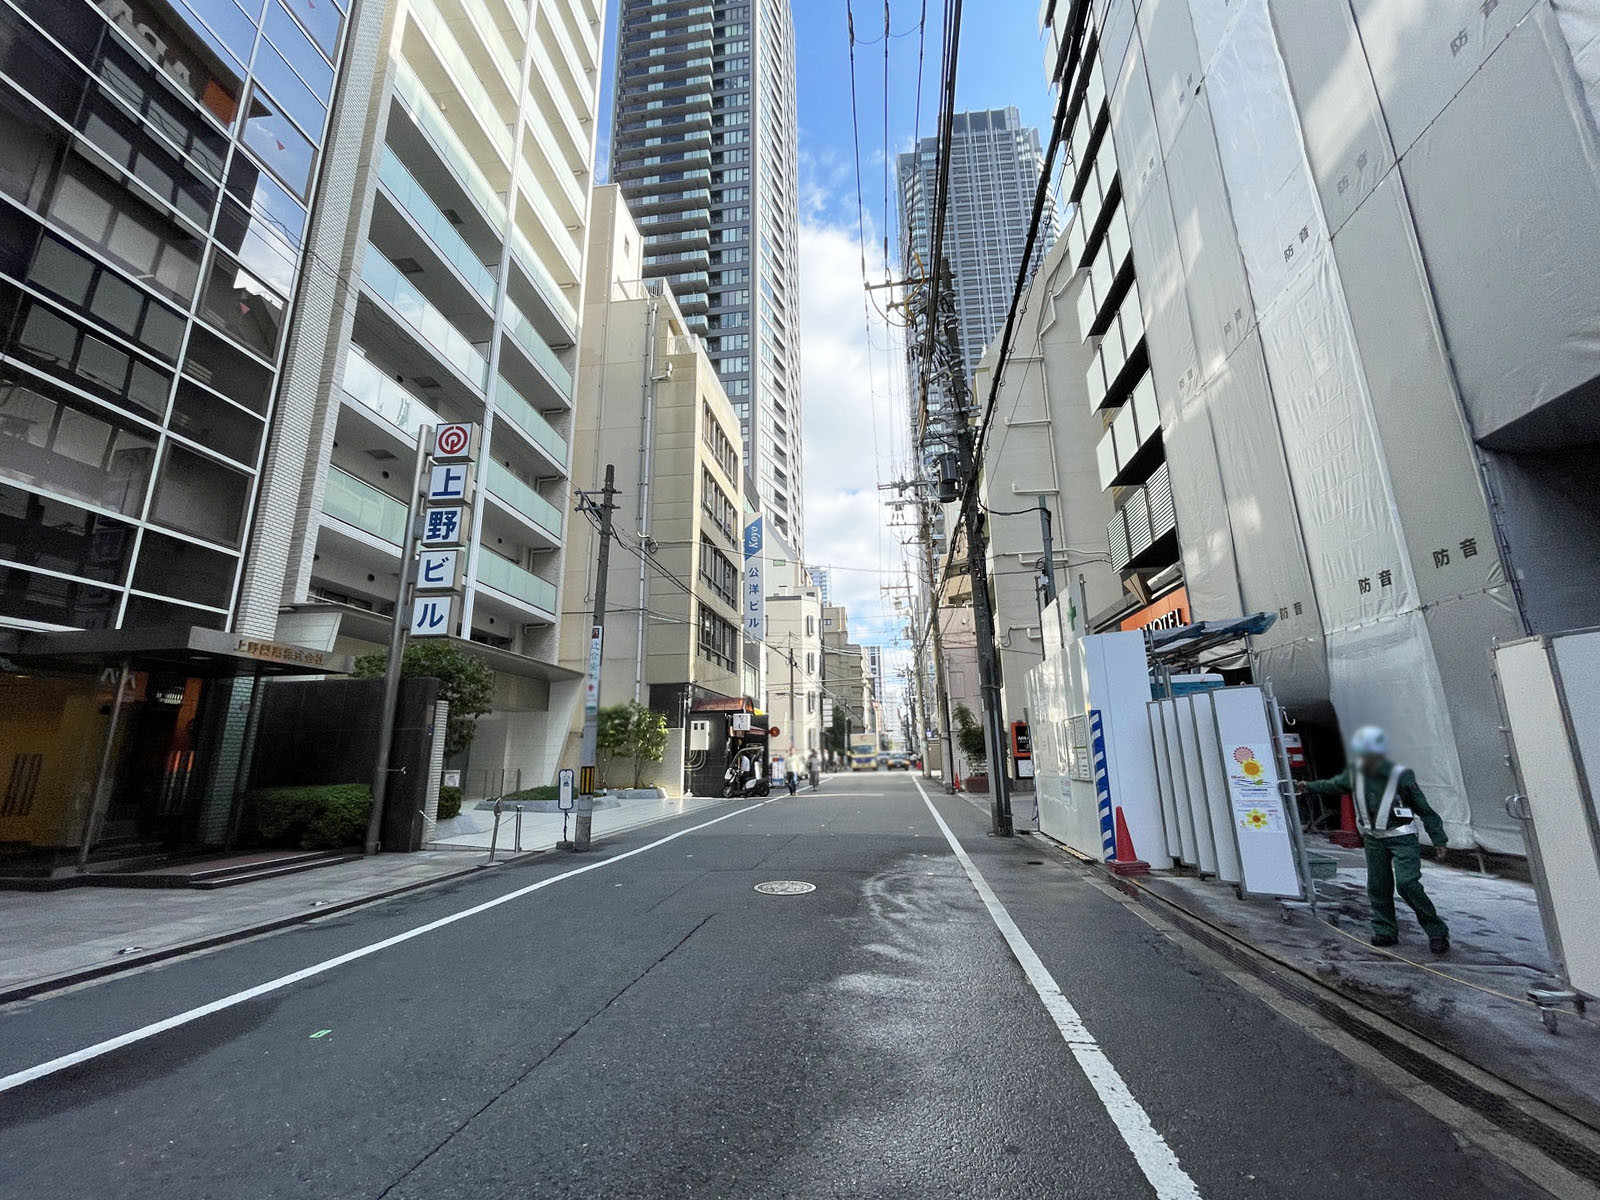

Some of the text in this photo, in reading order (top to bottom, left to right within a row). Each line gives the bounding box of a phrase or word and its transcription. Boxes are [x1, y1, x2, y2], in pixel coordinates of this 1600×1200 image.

[1284, 225, 1309, 263] 防音
[417, 467, 461, 629] 上野ビル
[749, 526, 760, 549] Koyo
[1433, 537, 1478, 568] 防音
[1358, 569, 1392, 594] 防音
[749, 567, 760, 628] 公洋ビル
[1279, 602, 1303, 621] 防音
